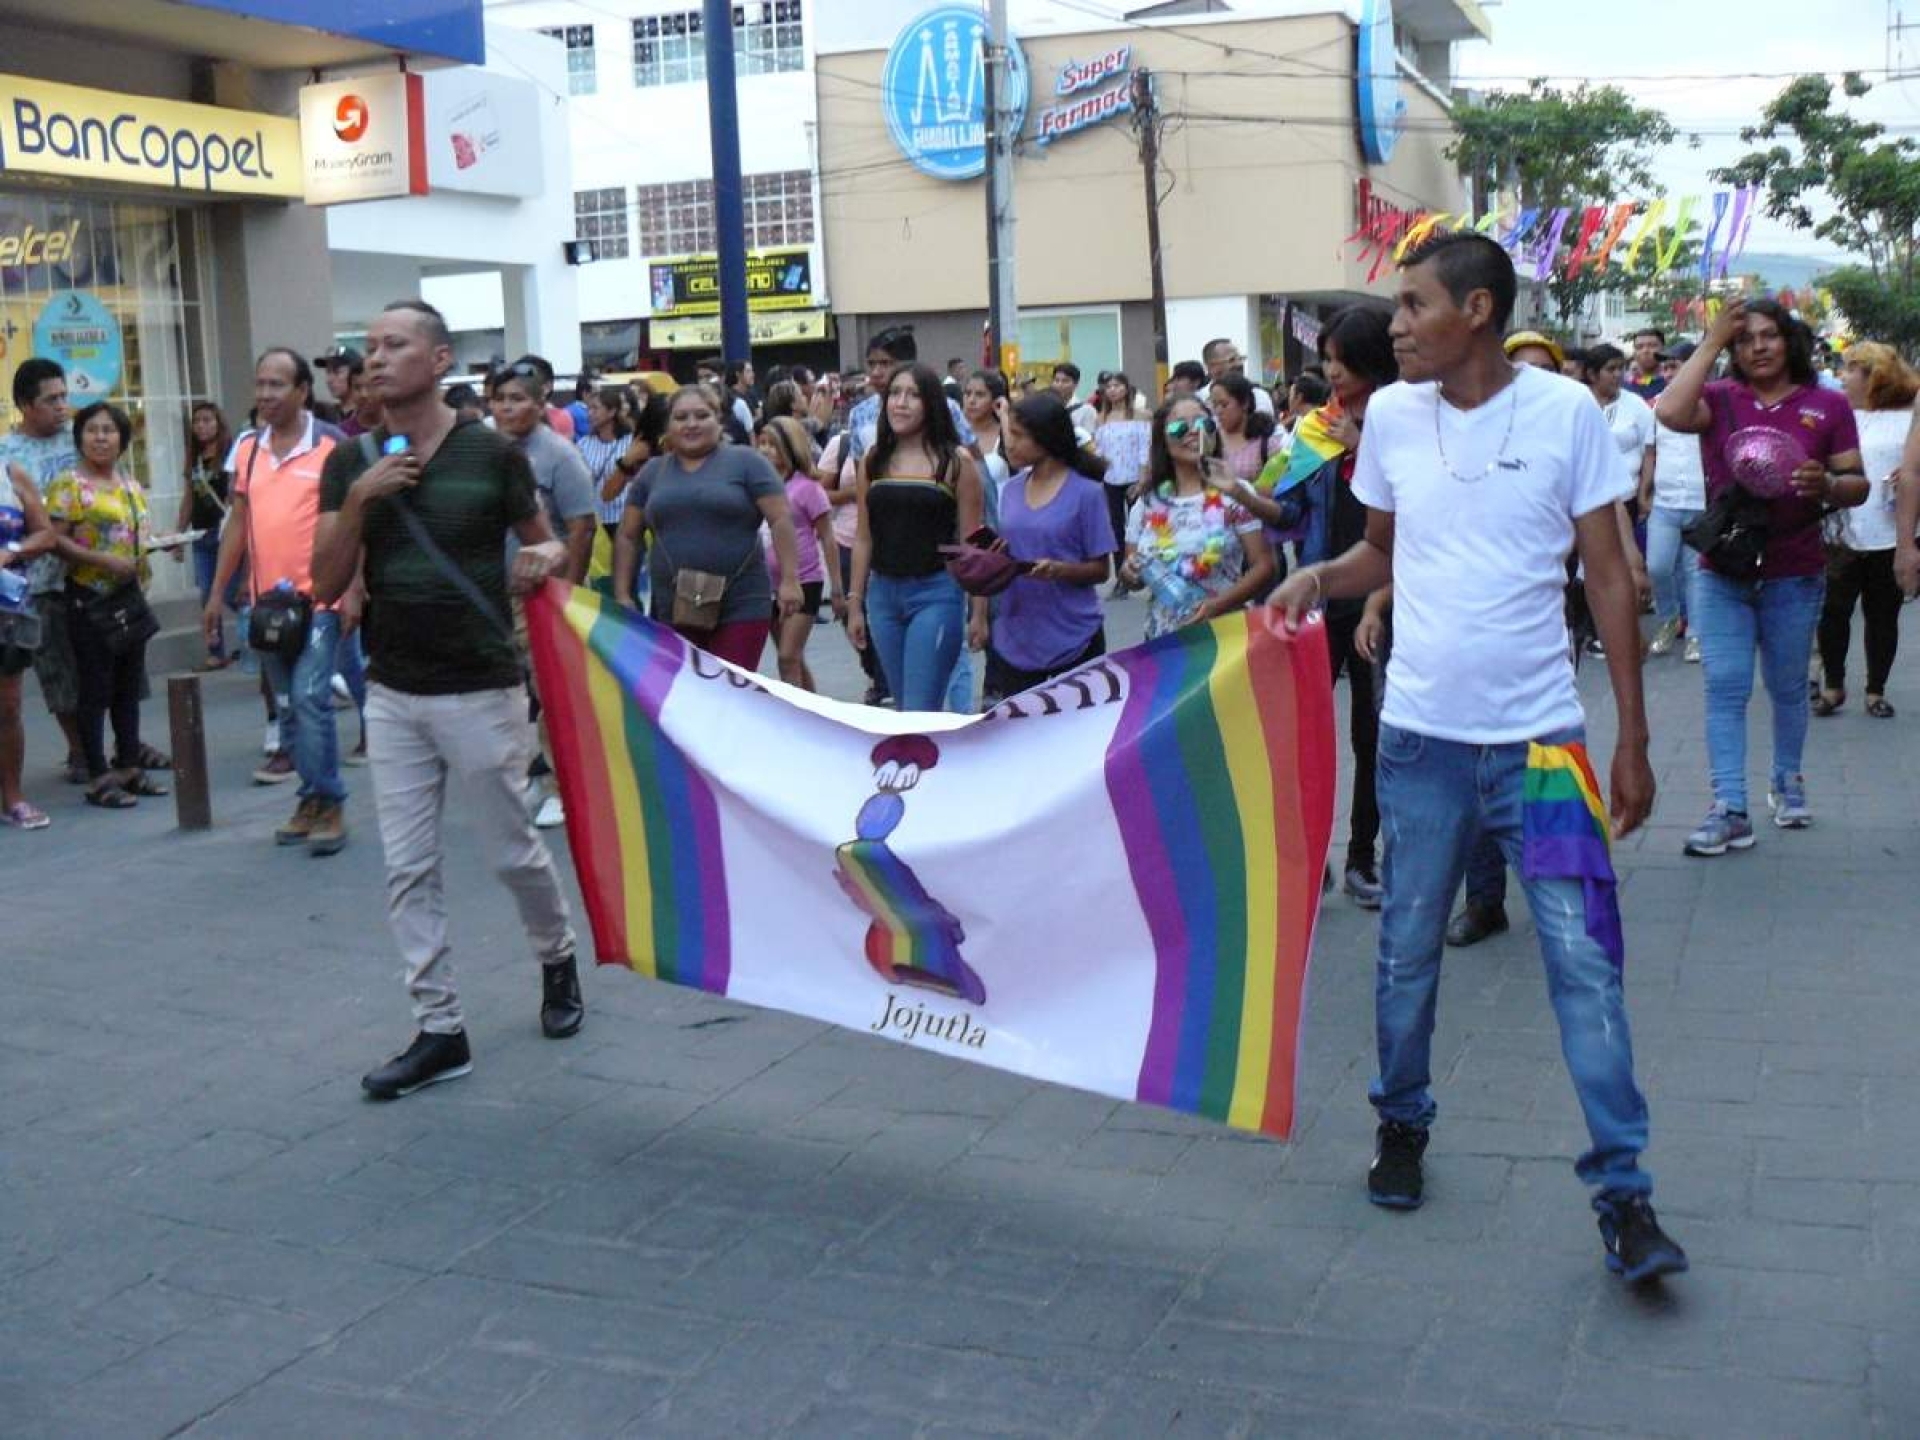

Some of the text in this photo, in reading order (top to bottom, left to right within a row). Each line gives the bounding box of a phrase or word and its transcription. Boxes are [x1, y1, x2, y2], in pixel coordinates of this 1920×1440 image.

[1061, 48, 1127, 90] Super
[1042, 86, 1128, 136] Farmac
[13, 98, 273, 191] BanCoppel
[315, 150, 393, 171] MneyGram
[0, 219, 80, 266] elcel
[871, 994, 987, 1048] Jojutla
